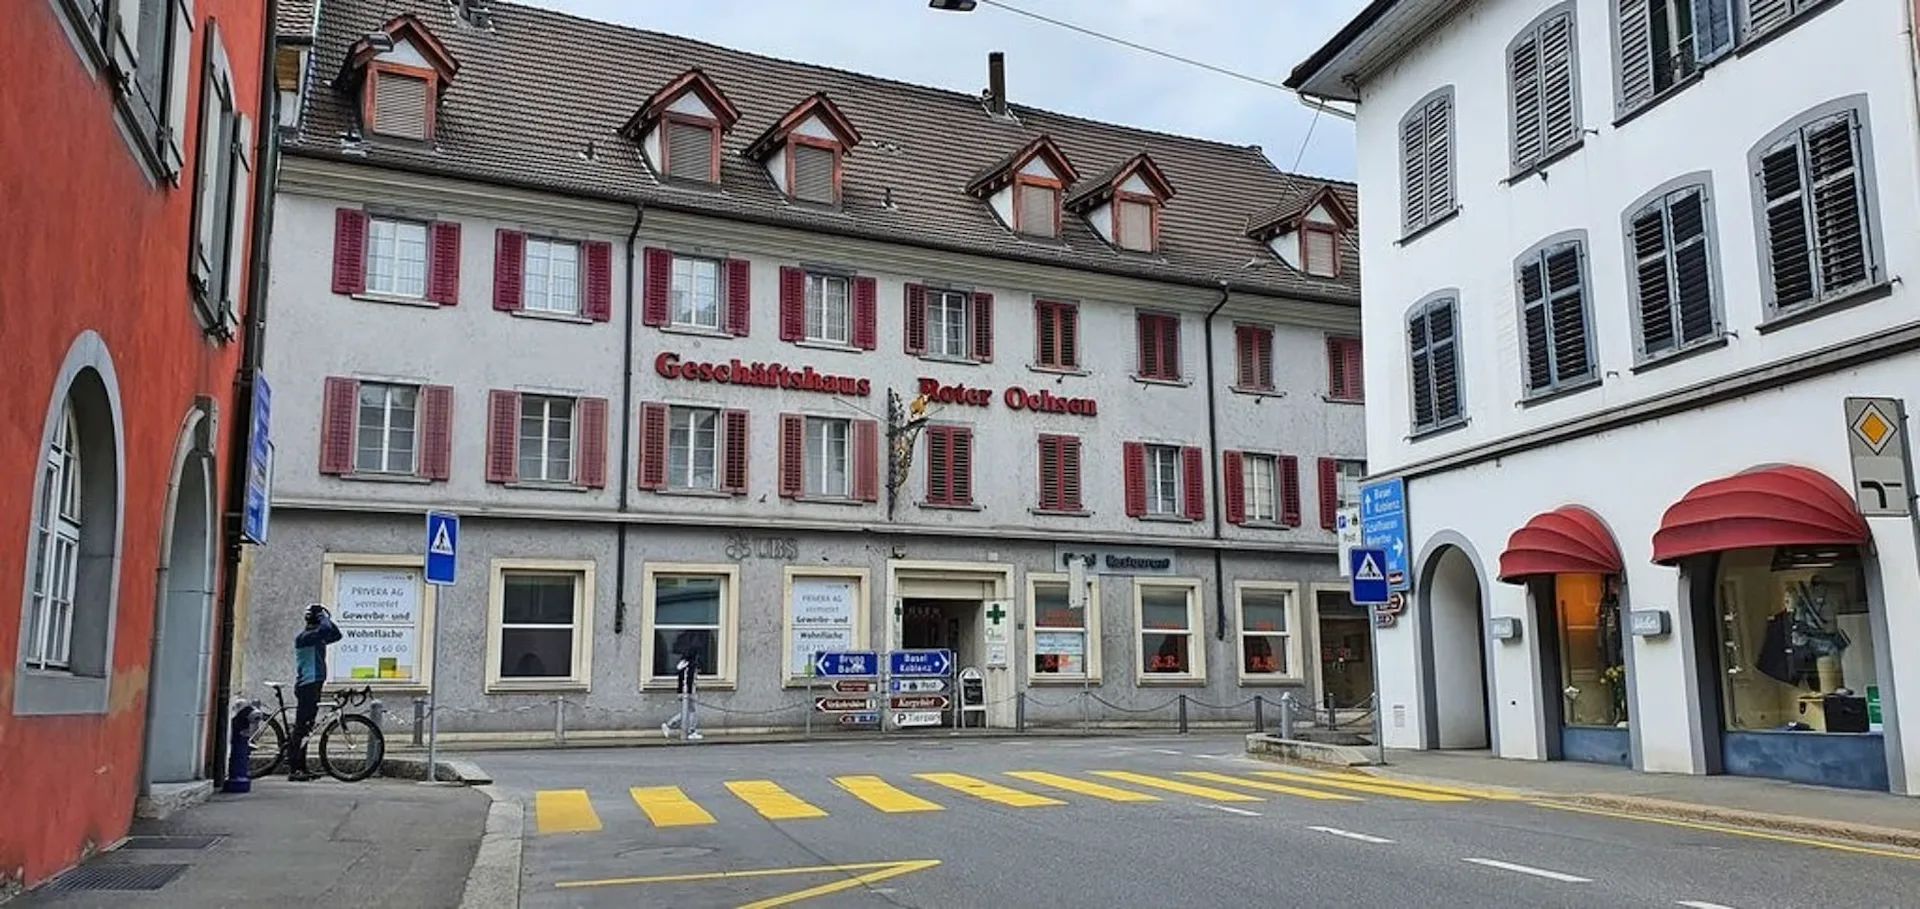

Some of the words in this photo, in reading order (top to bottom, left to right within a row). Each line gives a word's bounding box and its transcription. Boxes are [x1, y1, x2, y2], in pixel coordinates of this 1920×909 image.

[655, 352, 871, 397] Geschäftshaus
[918, 377, 992, 407] Roter
[1004, 386, 1097, 417] Ochsen
[755, 537, 798, 560] UBS
[390, 588, 404, 597] AG
[342, 611, 389, 620] Gewerbe-
[391, 612, 410, 620] und
[341, 644, 358, 653] 058
[362, 644, 379, 653] 715
[904, 653, 928, 662] Basel
[900, 663, 932, 672] Koblenz
[898, 714, 906, 724] P
